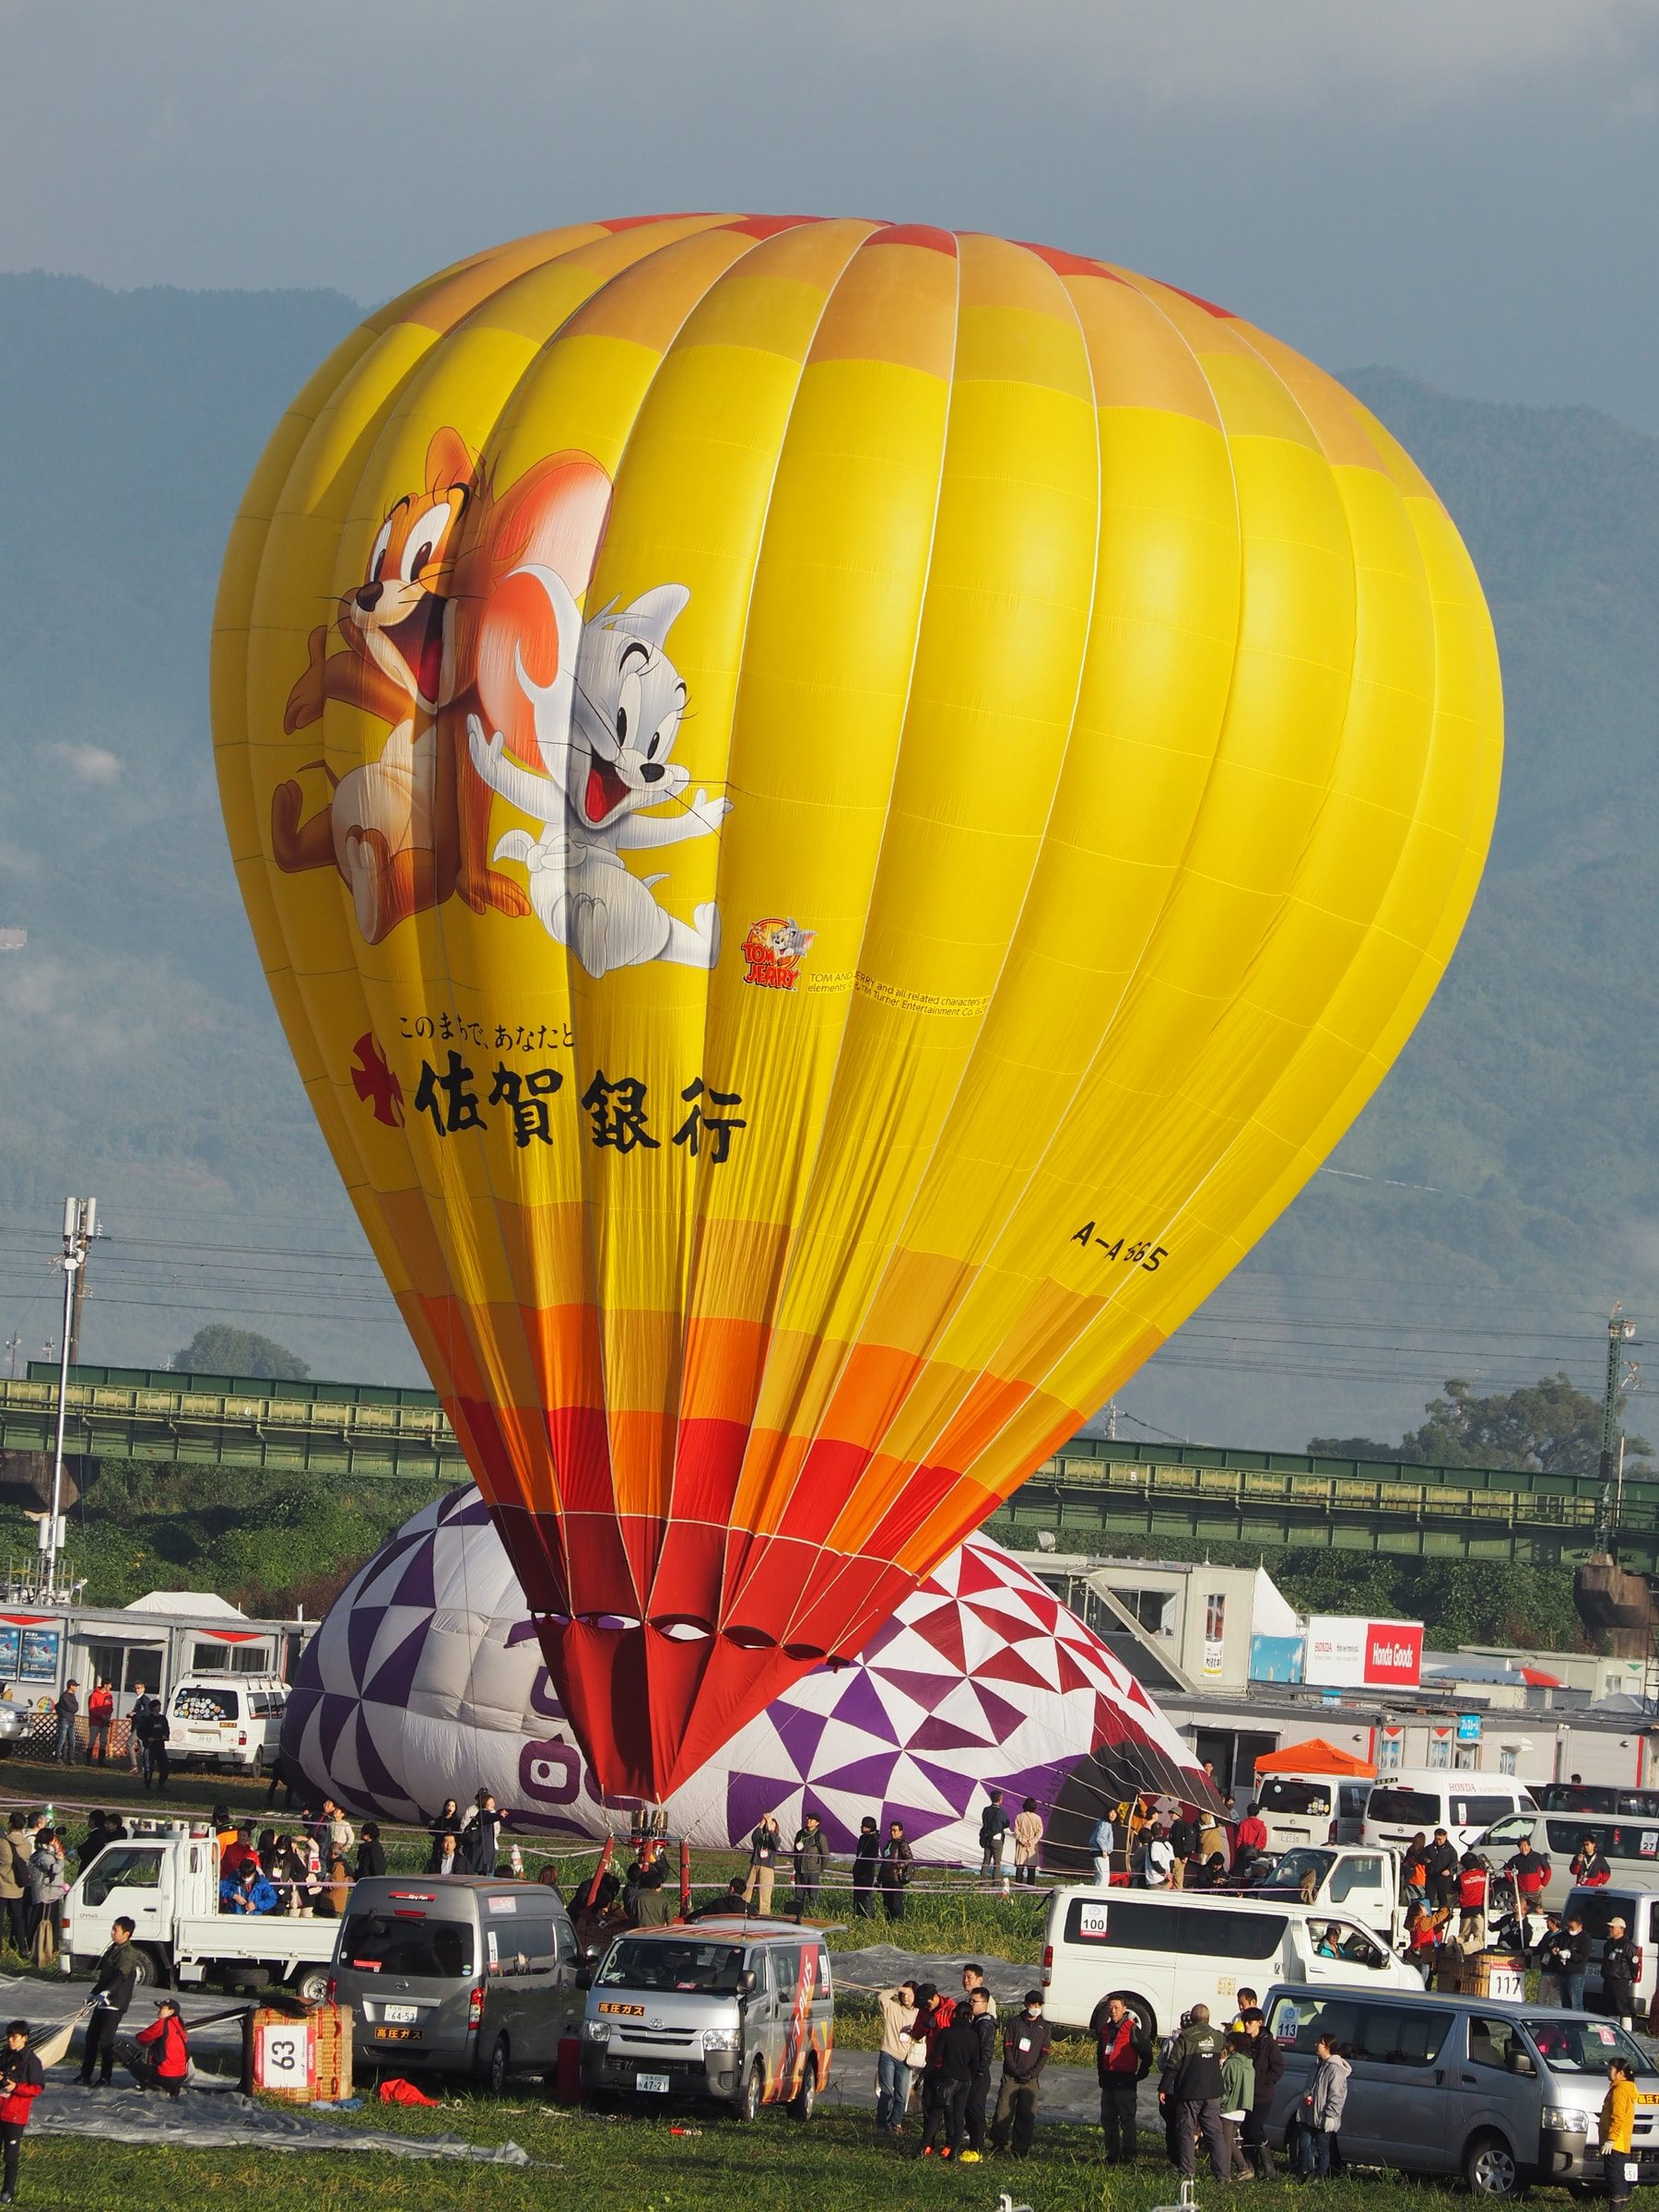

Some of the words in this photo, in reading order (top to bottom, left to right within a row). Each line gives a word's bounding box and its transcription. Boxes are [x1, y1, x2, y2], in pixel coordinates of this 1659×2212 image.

[741, 942, 775, 965] TOM
[743, 963, 800, 990] JERRY
[810, 973, 832, 982] TOM
[834, 971, 853, 982] AND
[877, 982, 894, 994] and
[895, 988, 907, 997] all
[908, 992, 940, 1006] related
[941, 996, 981, 1006] characters
[807, 982, 845, 993] elements
[873, 990, 900, 1006] Turner
[901, 1000, 960, 1016] Entertainment
[415, 1049, 747, 1165] 佐賀銀行
[1313, 1641, 1333, 1653] HONDA
[1372, 1641, 1393, 1666] Honda
[1394, 1642, 1413, 1668] Goods
[1448, 1783, 1477, 1793] HONDA
[1643, 1842, 1654, 1851] 27
[1083, 1919, 1104, 1930] 100
[798, 1954, 813, 2020] PLUS
[1496, 1976, 1521, 1995] 117
[391, 2012, 415, 2021] 64-53
[599, 2003, 643, 2016] 高圧ガス
[376, 2028, 421, 2040] 高圧ガス
[1278, 2023, 1297, 2036] 113
[271, 2041, 295, 2070] 63
[643, 2081, 666, 2091] 47-21
